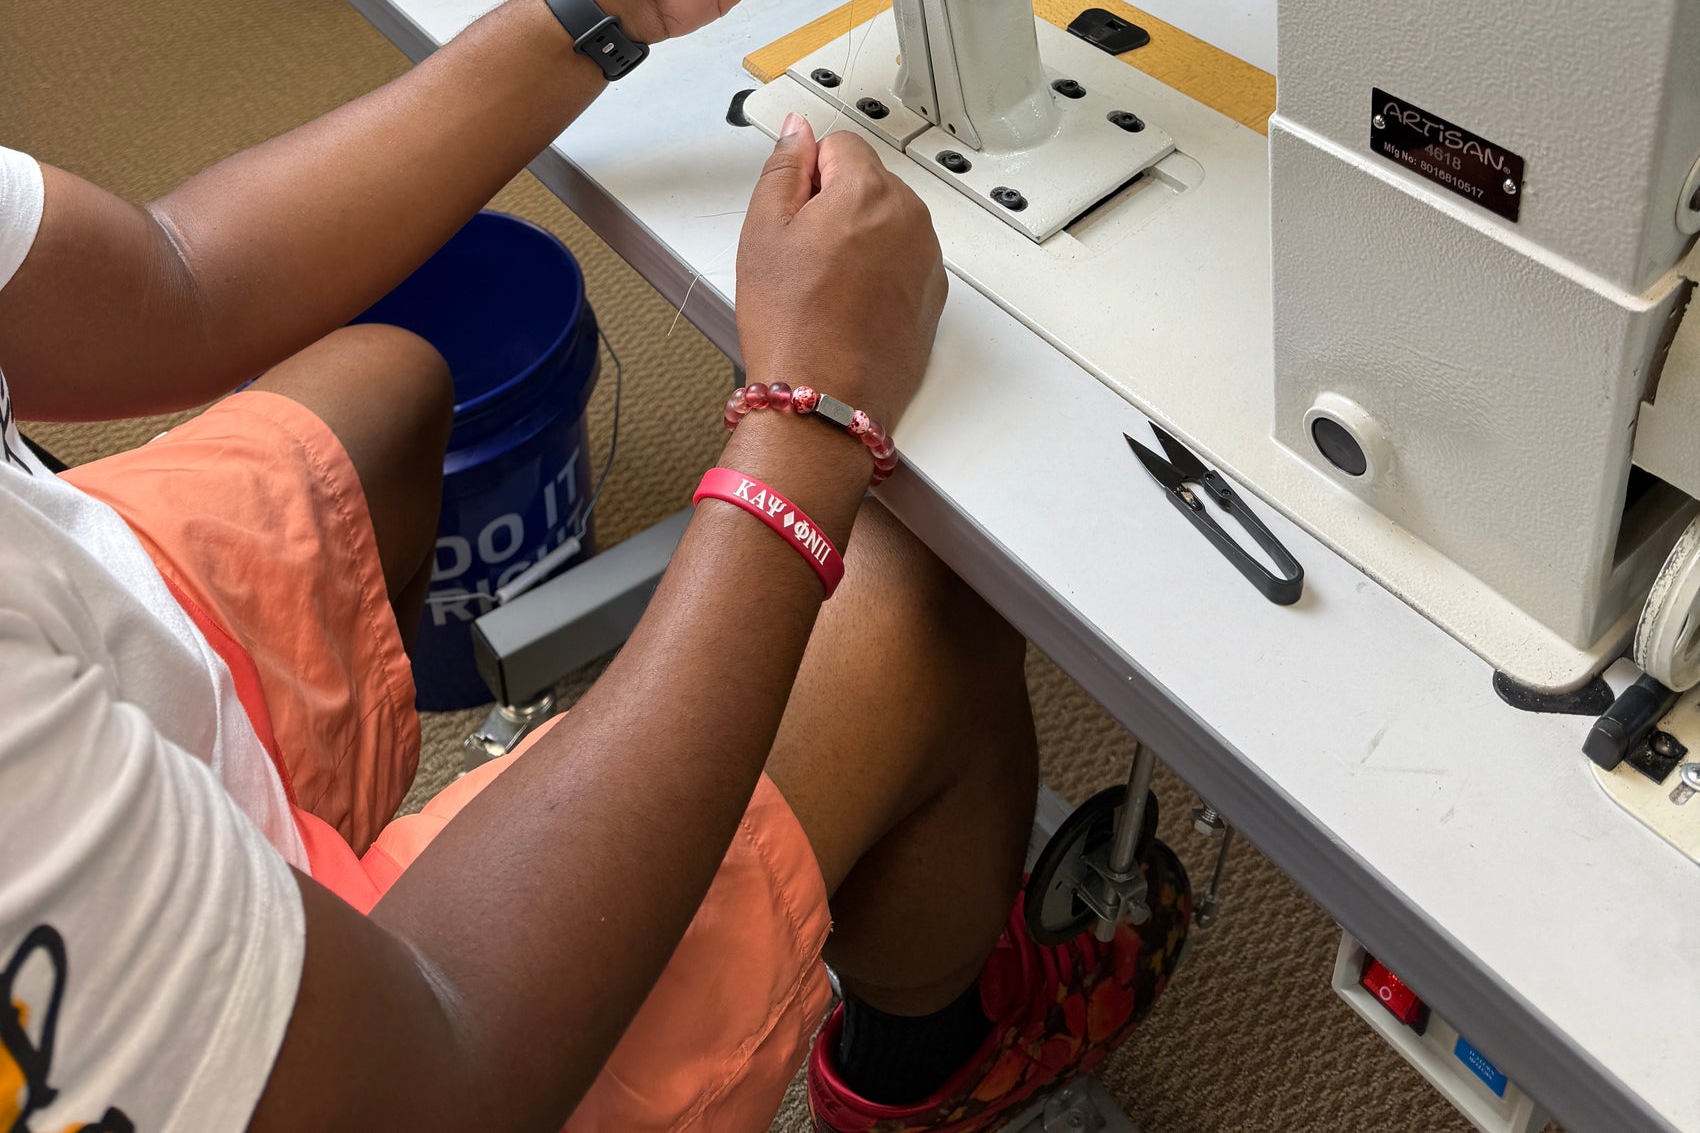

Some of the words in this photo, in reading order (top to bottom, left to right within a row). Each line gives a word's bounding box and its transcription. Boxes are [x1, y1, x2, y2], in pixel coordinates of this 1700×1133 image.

[1383, 141, 1400, 159] Mfg
[1401, 150, 1418, 166] No:
[1424, 144, 1462, 170] 4618
[431, 513, 525, 582] DO
[544, 446, 580, 529] IT
[427, 497, 585, 627] RIT
